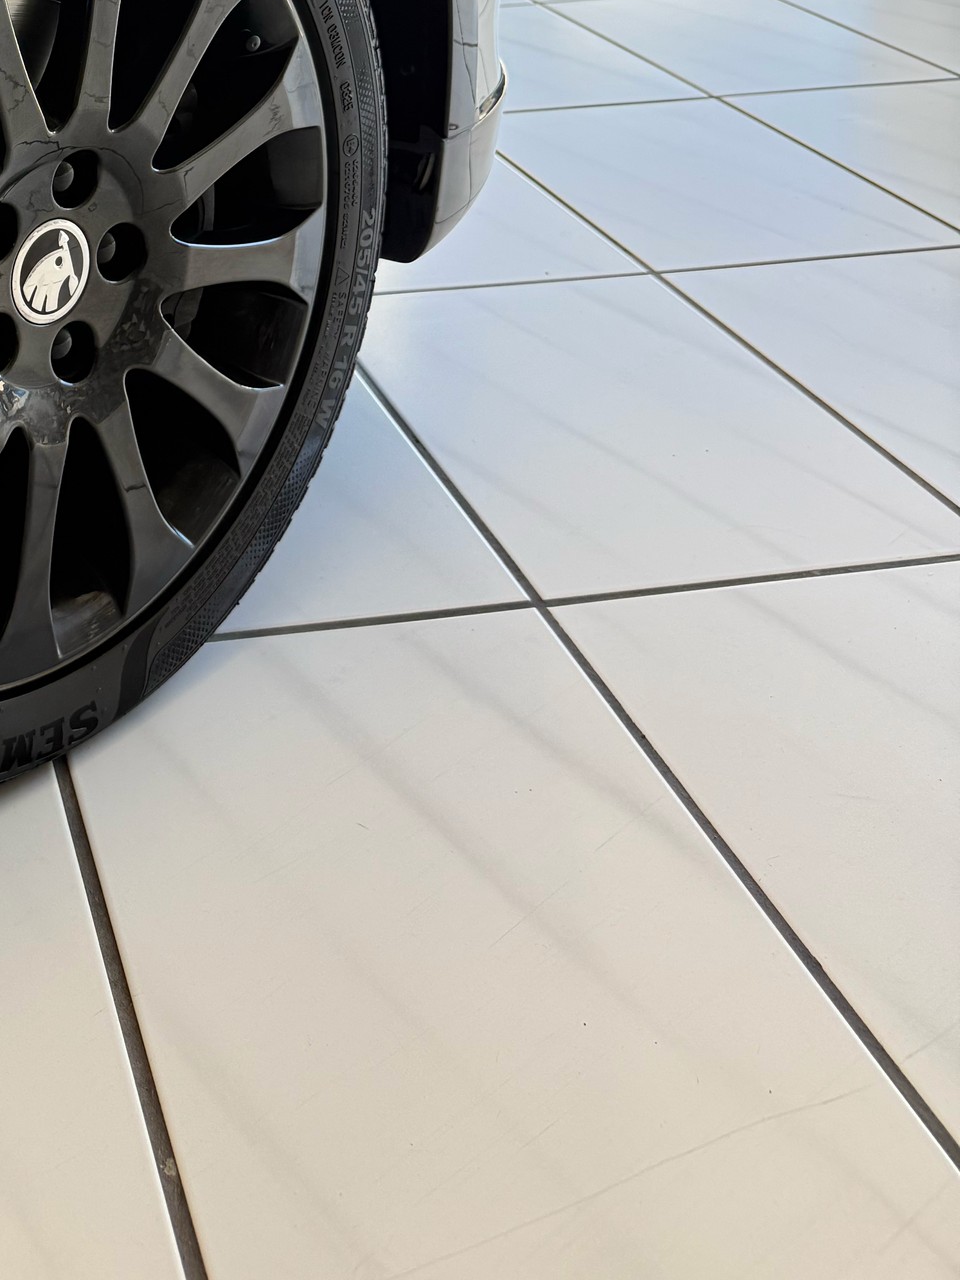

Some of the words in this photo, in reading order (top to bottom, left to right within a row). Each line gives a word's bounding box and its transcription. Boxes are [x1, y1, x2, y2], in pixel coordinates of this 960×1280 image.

[348, 208, 376, 316] 205/45
[339, 324, 357, 347] R
[328, 355, 348, 390] 16
[314, 397, 336, 429] W
